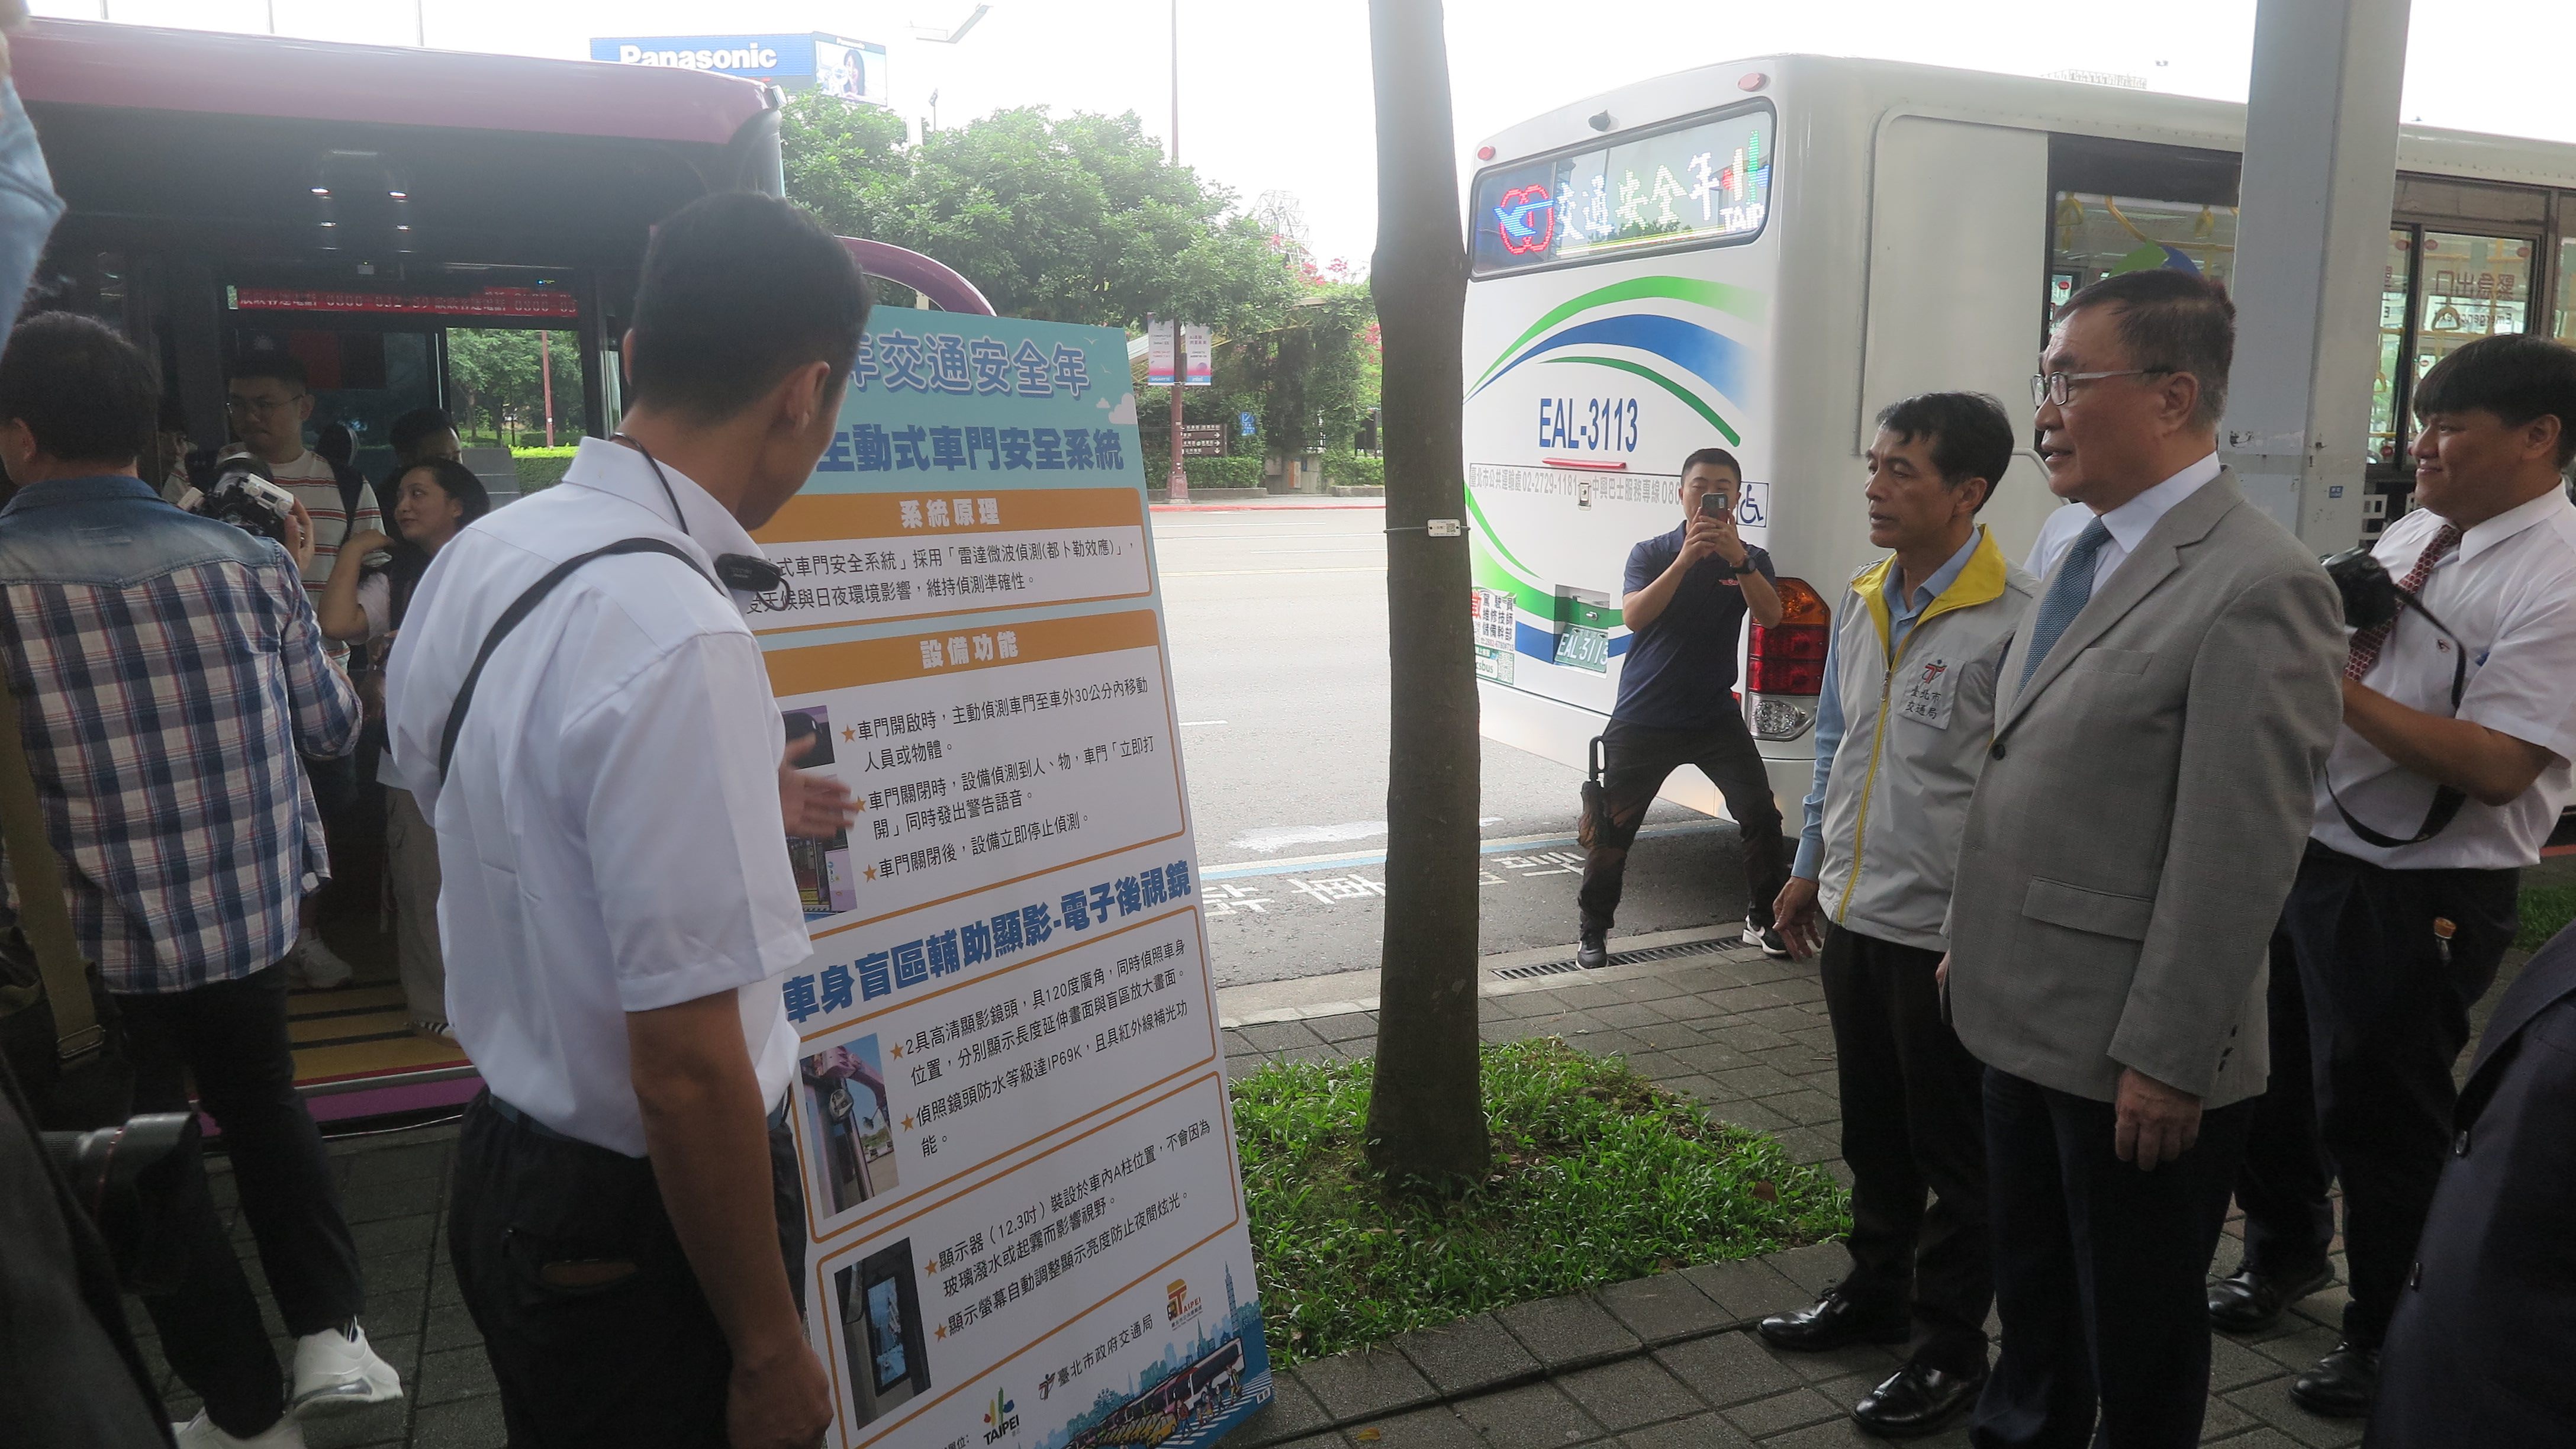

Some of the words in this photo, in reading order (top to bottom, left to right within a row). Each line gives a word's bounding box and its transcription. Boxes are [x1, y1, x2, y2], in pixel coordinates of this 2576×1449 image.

[620, 42, 777, 69] Panasonic
[1539, 398, 1638, 452] EAL-3113
[816, 423, 1125, 472] 主動式車門安全系統
[901, 497, 1000, 529] 系統原理
[769, 538, 1133, 578] 式車門安全系統」採用「雷達微波偵測(都卜勒效應)」，
[920, 630, 1019, 669] 設備功能
[1905, 701, 1937, 719] 交通局
[1910, 684, 1941, 703] 臺北市
[865, 739, 952, 772] 人員或物體。
[879, 811, 1089, 879] 車門關閉後，設備立即停止偵測。
[783, 860, 1192, 1024] 車身盲區輔助顯影-電子後視鏡
[921, 1135, 948, 1158] 能。
[943, 1196, 1115, 1298] 玻璃潑水或起霧而影響視野。
[1057, 1313, 1154, 1387] 臺北市政府交通局
[942, 1434, 970, 1449] 單位:
[983, 1414, 1020, 1446] TAIPEI
